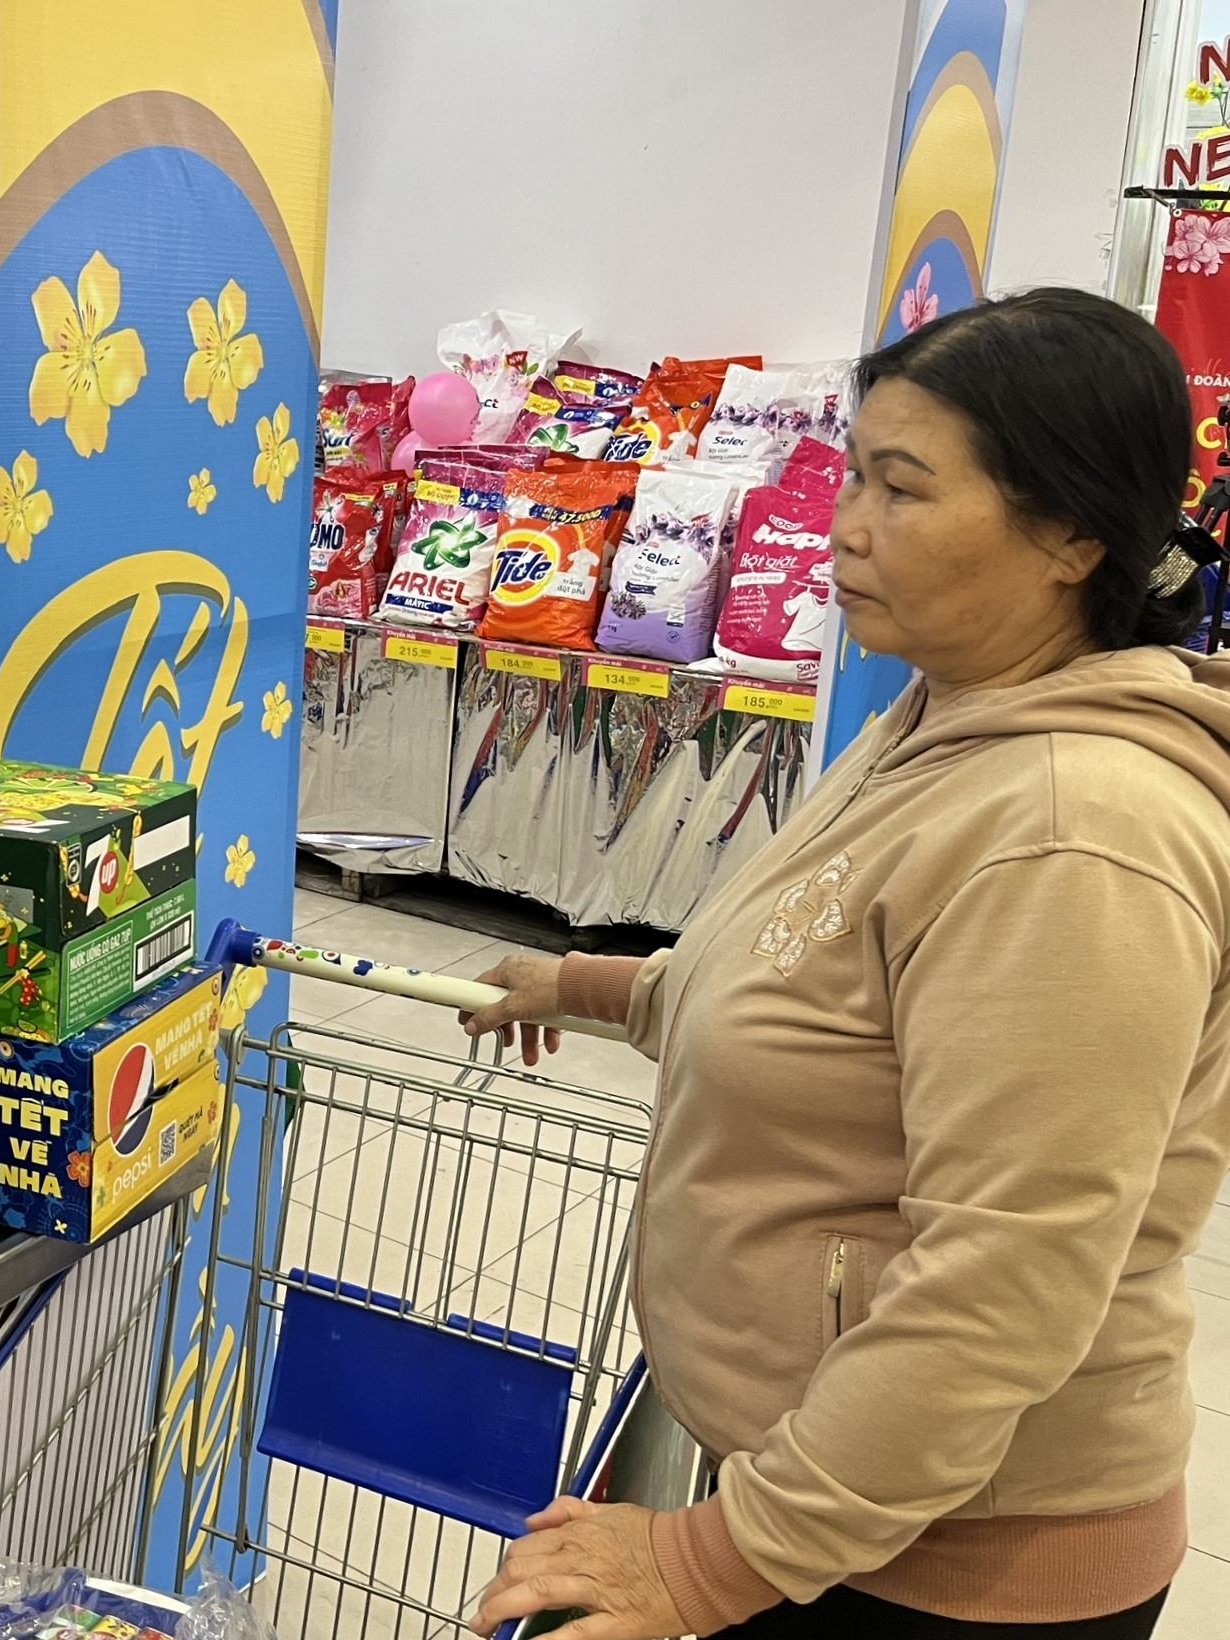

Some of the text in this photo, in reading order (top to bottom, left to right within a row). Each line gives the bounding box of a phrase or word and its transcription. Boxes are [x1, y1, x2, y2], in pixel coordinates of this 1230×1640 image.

[388, 570, 471, 607] ARIEL
[491, 550, 553, 593] Tide
[154, 1020, 192, 1055] MANG
[10, 1134, 52, 1167] VỀ
[111, 1146, 153, 1206] pepsi
